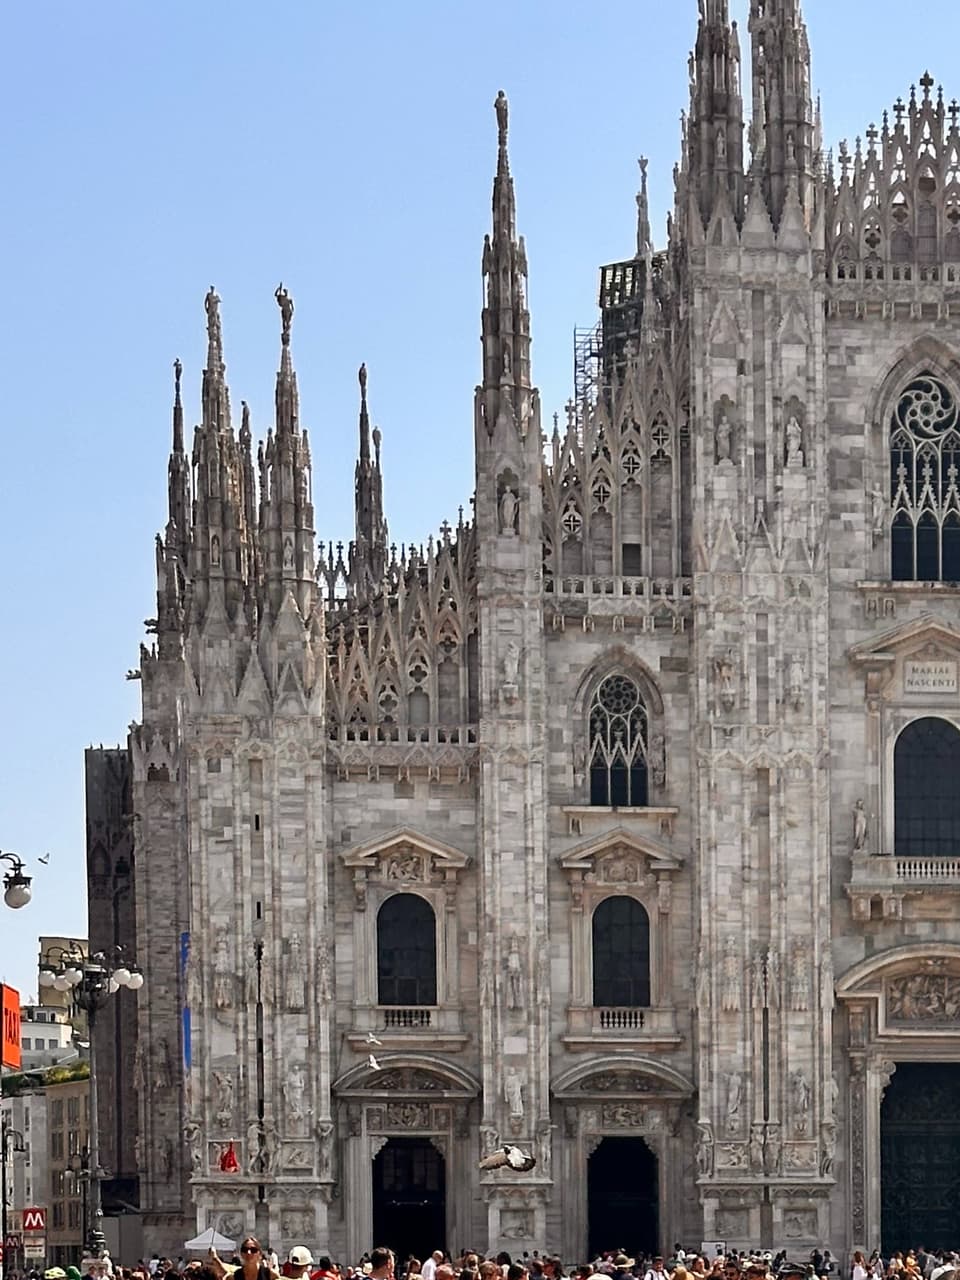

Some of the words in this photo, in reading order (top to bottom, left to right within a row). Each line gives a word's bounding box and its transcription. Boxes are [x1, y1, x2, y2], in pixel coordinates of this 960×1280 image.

[4, 1008, 20, 1047] TAXI
[25, 1212, 45, 1227] M
[6, 1237, 20, 1247] M
